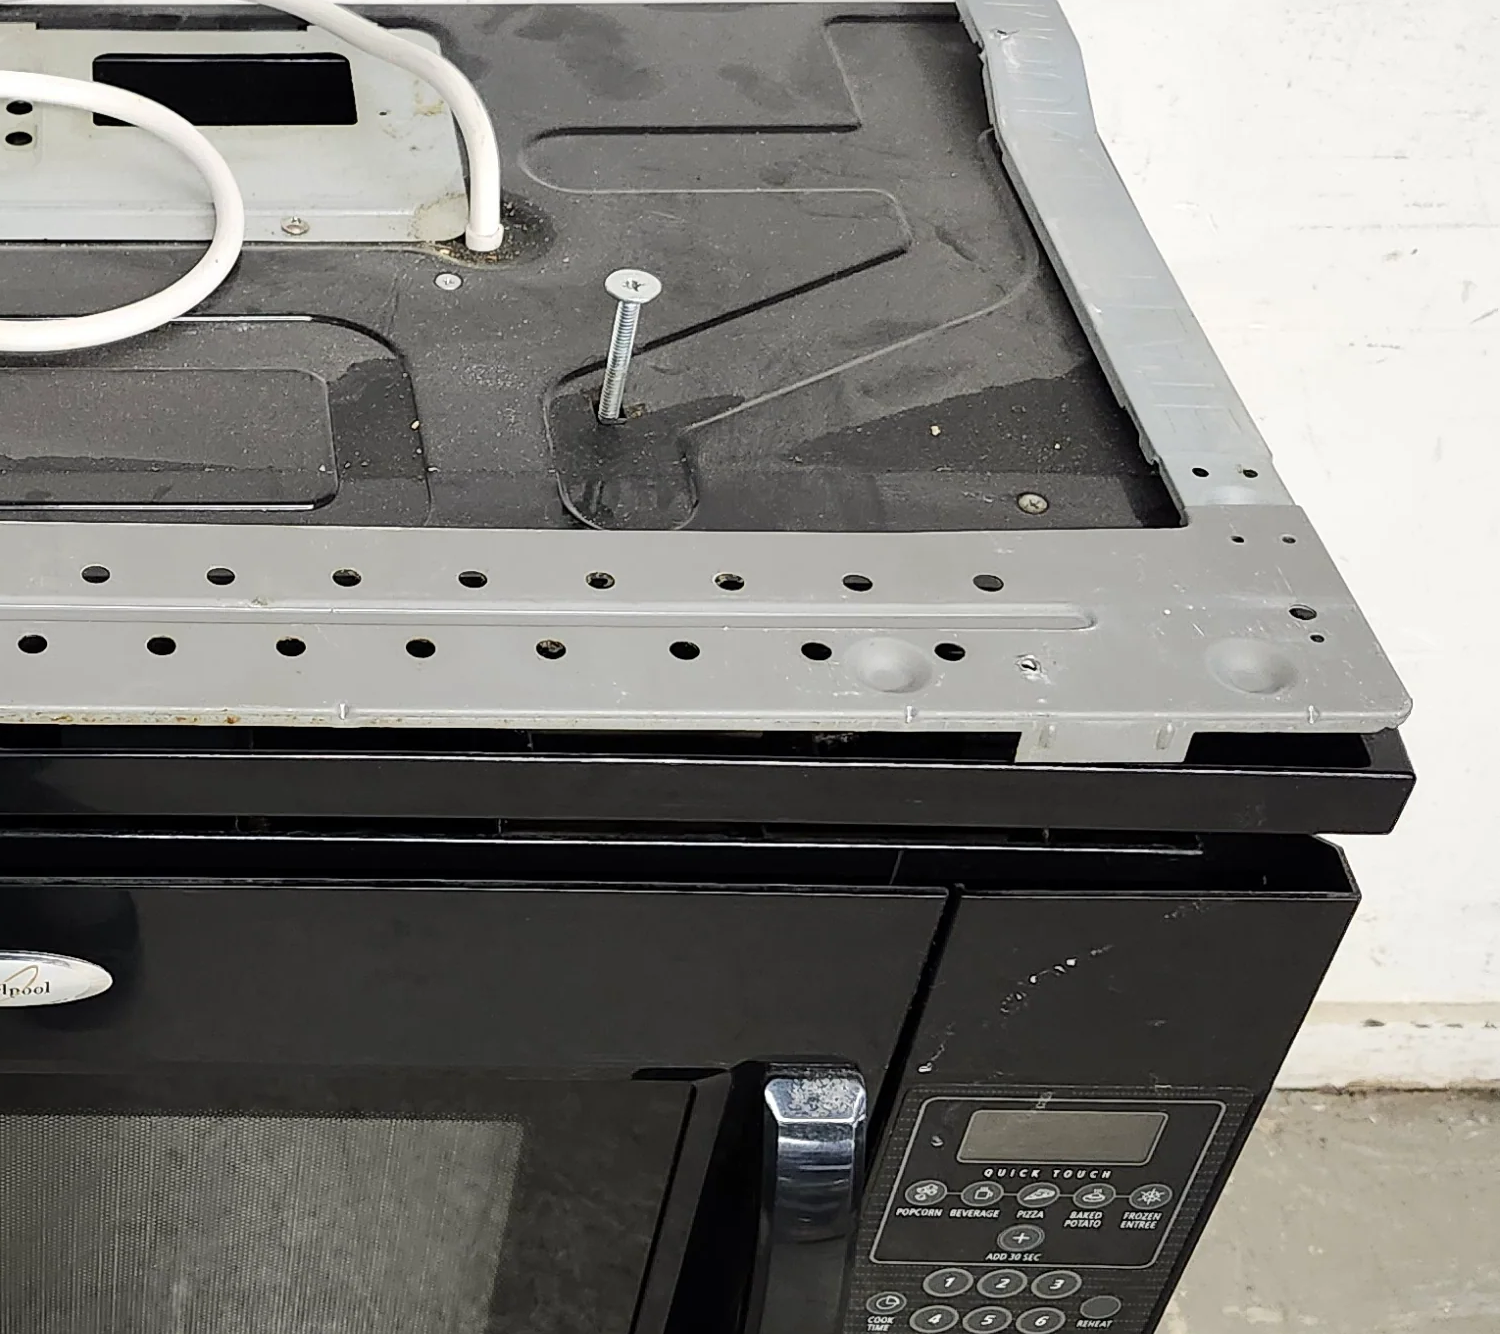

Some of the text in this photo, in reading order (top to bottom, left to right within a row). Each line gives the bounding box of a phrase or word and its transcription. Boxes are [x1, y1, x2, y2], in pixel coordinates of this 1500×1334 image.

[983, 1168, 1112, 1180] QUICK TOUCH
[896, 1208, 943, 1217] POPCORN
[950, 1208, 1000, 1218] BEVERAGE
[1016, 1210, 1044, 1219] PIZZA
[1069, 1211, 1103, 1220] BAKED
[1122, 1212, 1162, 1221] FROZEN
[1063, 1219, 1102, 1228] POTATO
[1120, 1220, 1158, 1230] ENTREE
[985, 1253, 1043, 1262] ADD 30 SEC
[945, 1277, 956, 1287] 1
[995, 1278, 1011, 1289] 2
[1049, 1279, 1065, 1290] 3
[867, 1316, 895, 1325] COOK
[927, 1314, 942, 1324] 4
[980, 1315, 997, 1326] 5
[1034, 1316, 1050, 1326] 6
[866, 1323, 889, 1332] TIME
[1076, 1320, 1113, 1328] REHEAT
